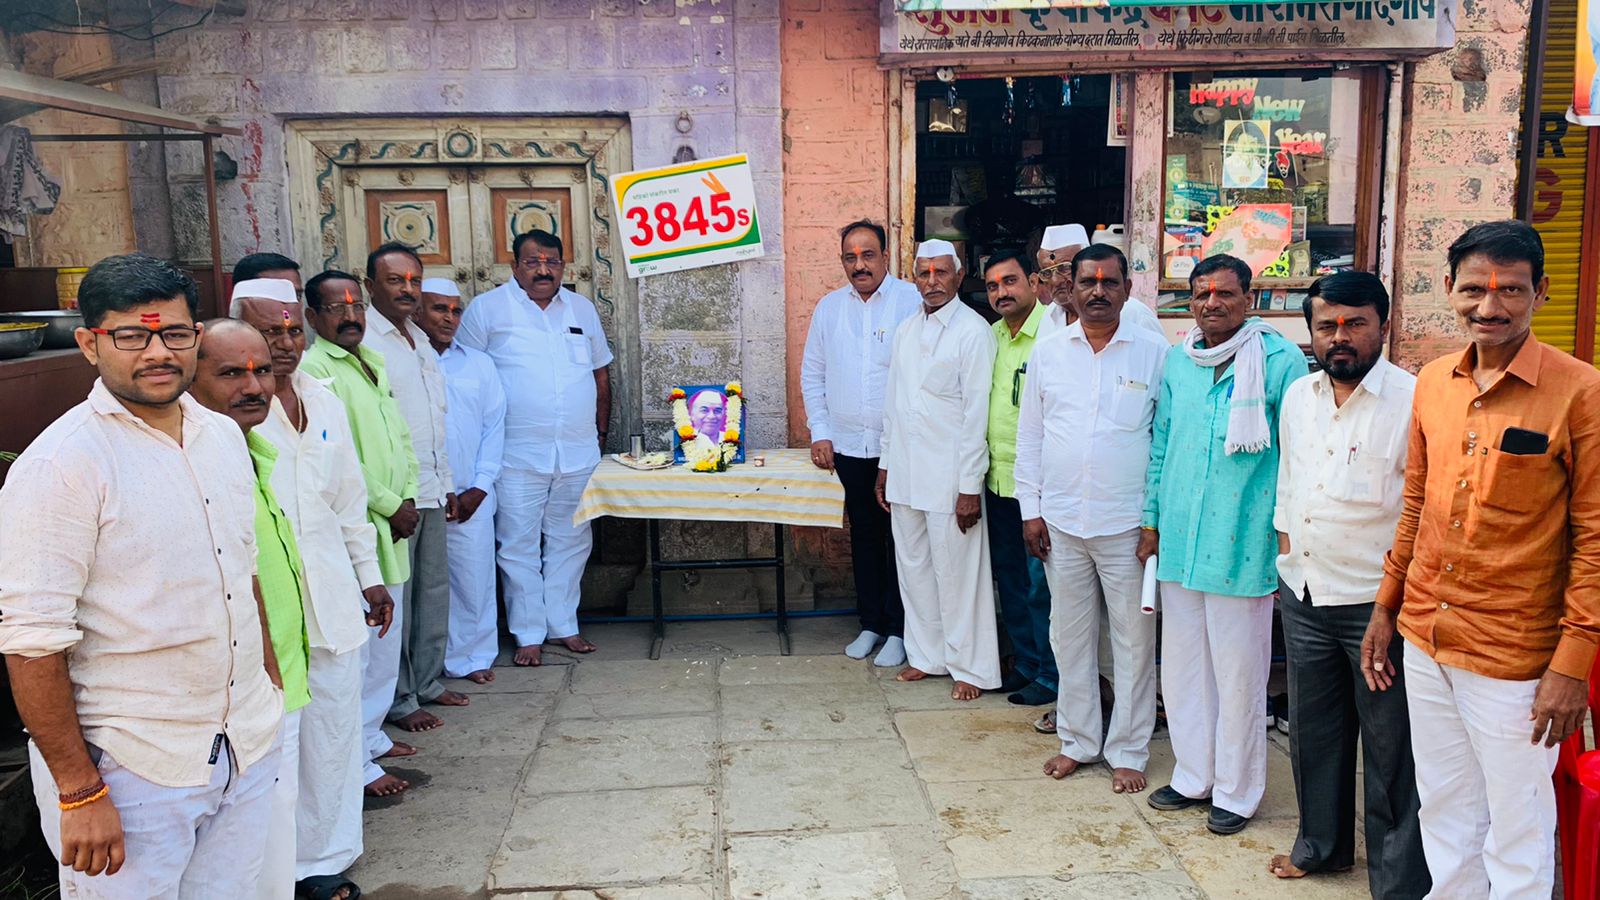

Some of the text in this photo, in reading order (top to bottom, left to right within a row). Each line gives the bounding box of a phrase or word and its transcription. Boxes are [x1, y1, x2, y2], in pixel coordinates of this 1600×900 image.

[899, 34, 914, 50] येथे
[1158, 28, 1175, 46] येथे
[1189, 78, 1258, 107] Happy
[1252, 96, 1305, 122] New
[1275, 128, 1326, 155] Year
